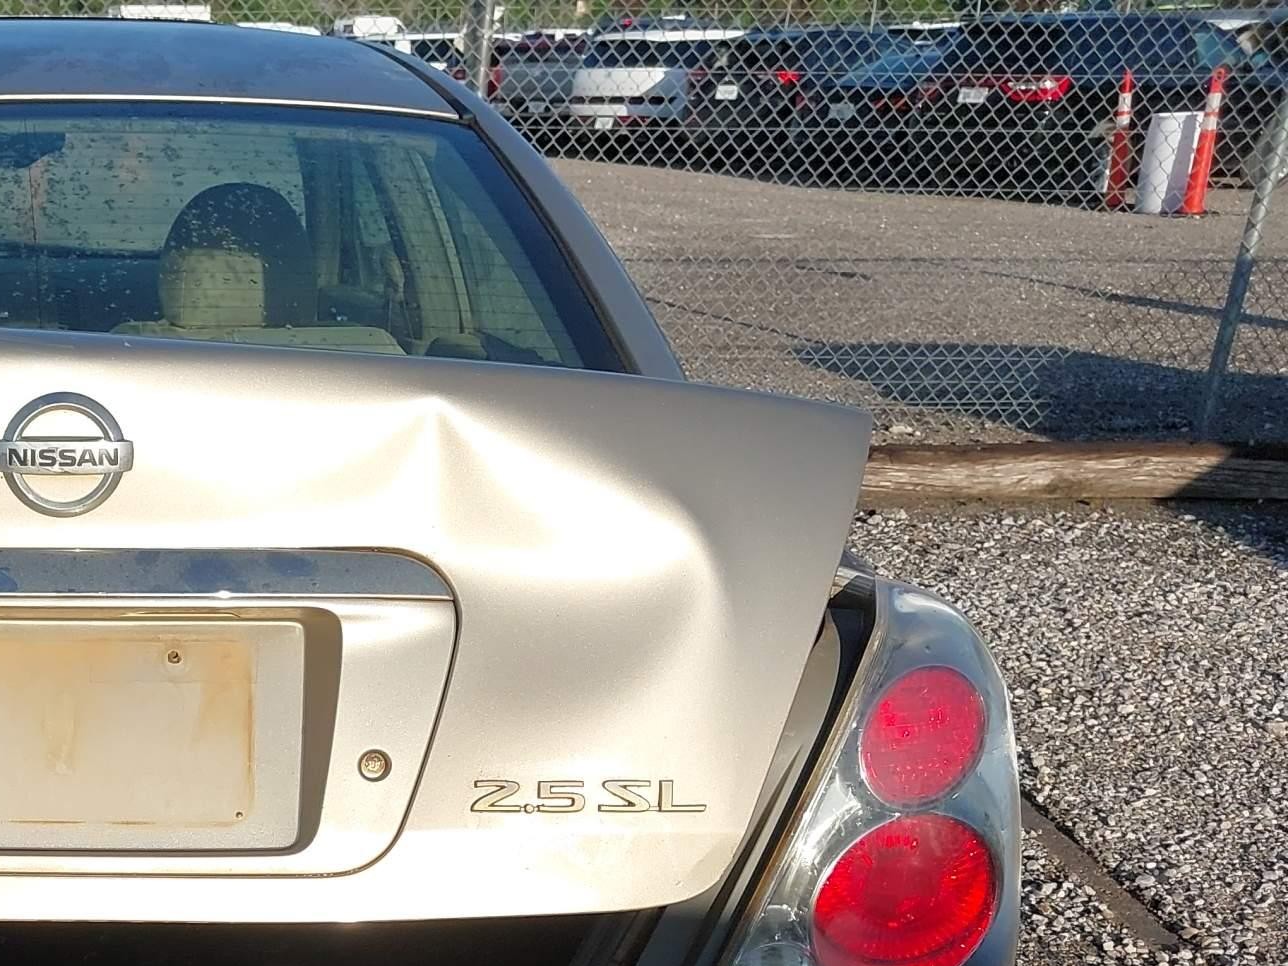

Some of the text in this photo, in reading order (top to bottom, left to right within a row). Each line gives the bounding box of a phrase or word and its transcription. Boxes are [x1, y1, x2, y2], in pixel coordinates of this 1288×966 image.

[7, 447, 120, 468] NISSAN
[470, 779, 707, 814] 2.5 SL
